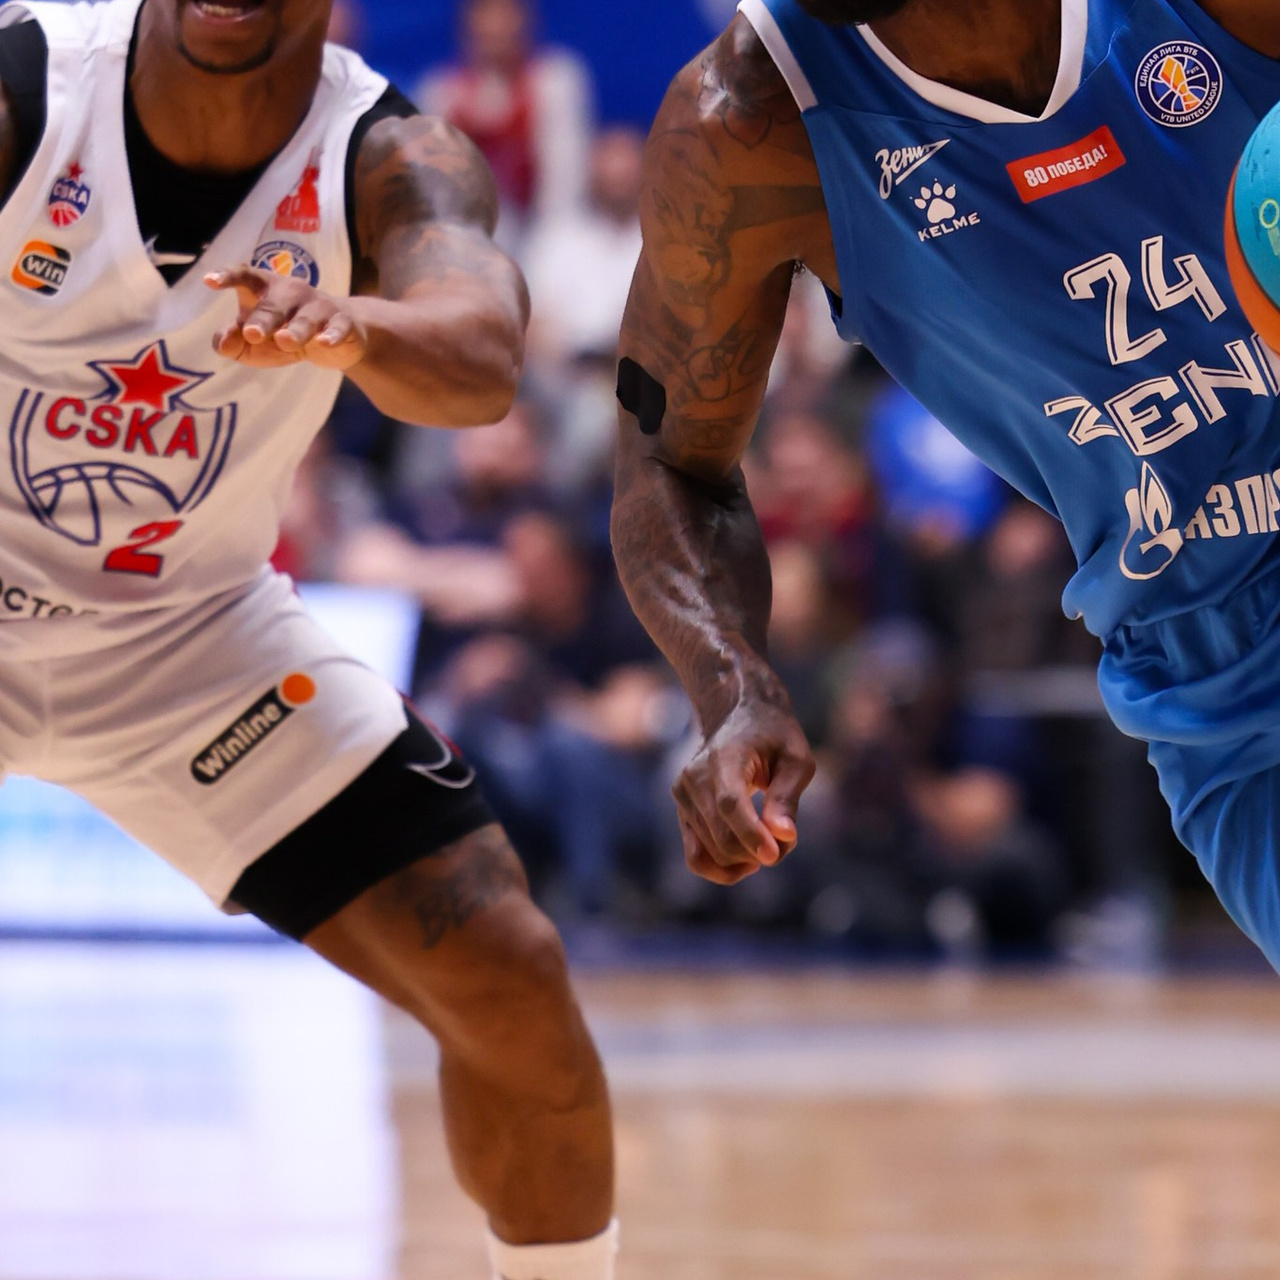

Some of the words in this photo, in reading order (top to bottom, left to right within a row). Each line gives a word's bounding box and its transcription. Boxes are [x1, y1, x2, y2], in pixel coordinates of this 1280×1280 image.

[1140, 54, 1160, 87] ЕДИНАЯ
[1159, 45, 1182, 57] ЛИГА
[1183, 46, 1199, 56] ВТБ
[1160, 113, 1175, 123] VTB
[1176, 108, 1205, 123] UNITED
[1202, 80, 1219, 110] LEAGUE
[1023, 166, 1048, 188] 80
[1047, 144, 1108, 180] ПОБЕДА!
[917, 212, 980, 242] KELME
[26, 255, 66, 287] Win
[1063, 235, 1227, 365] 24
[45, 396, 198, 460] CSKA
[102, 519, 184, 579] 2
[195, 702, 281, 778] Winline
